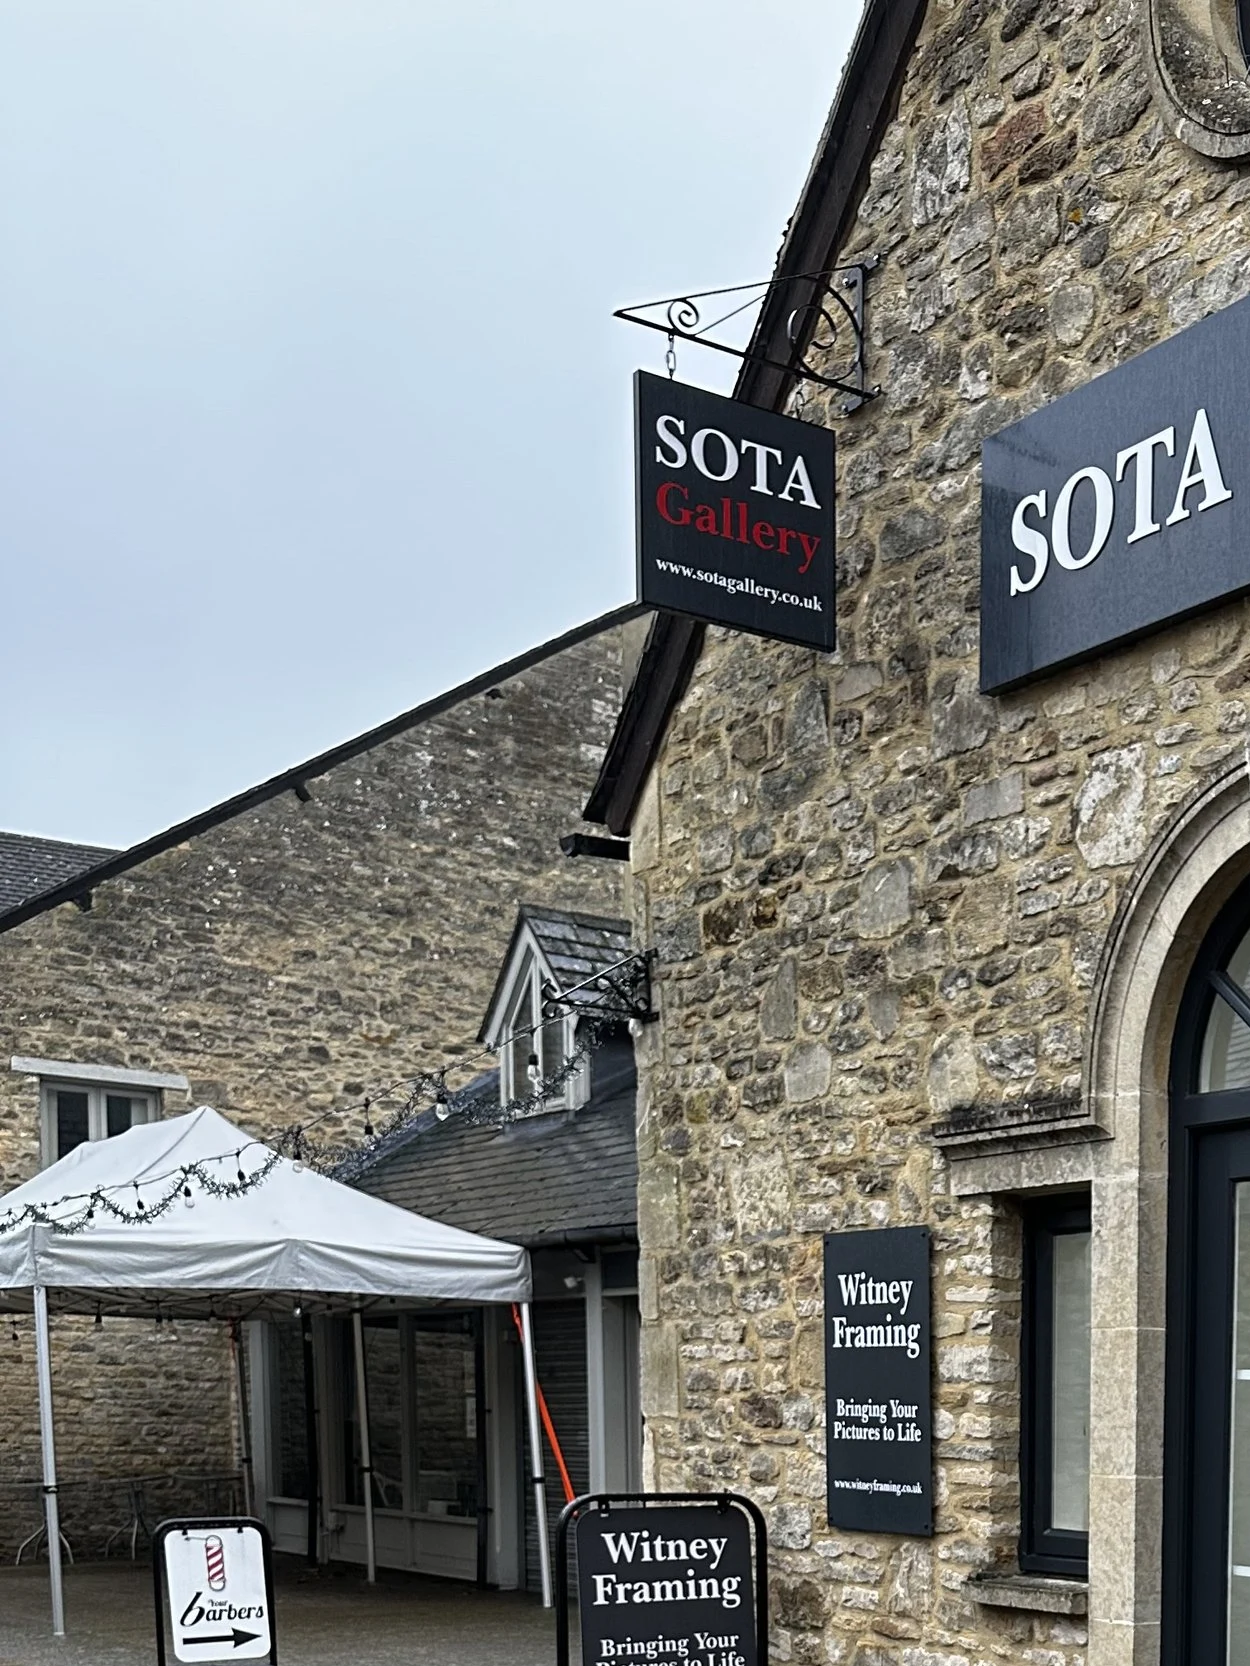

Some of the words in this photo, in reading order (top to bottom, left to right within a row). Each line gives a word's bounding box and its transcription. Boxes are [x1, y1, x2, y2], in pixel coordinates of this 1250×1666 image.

[655, 414, 822, 510] SOTA
[1008, 407, 1233, 597] SOTA
[655, 481, 821, 574] Gallery
[655, 558, 823, 612] www.sotagallery.co.uk
[837, 1271, 914, 1315] Witney
[831, 1313, 921, 1359] Framing
[833, 1421, 880, 1441] Pictures
[883, 1425, 895, 1441] to
[897, 1422, 922, 1442] Life
[836, 1398, 887, 1424] Bringing
[889, 1399, 918, 1418] Your
[833, 1478, 923, 1497] www.witneyframing.co.uk
[600, 1529, 728, 1570] Witney
[180, 1591, 264, 1627] barbers
[591, 1568, 742, 1609] Framing
[599, 1634, 690, 1660] Bringing
[693, 1631, 740, 1650] Your
